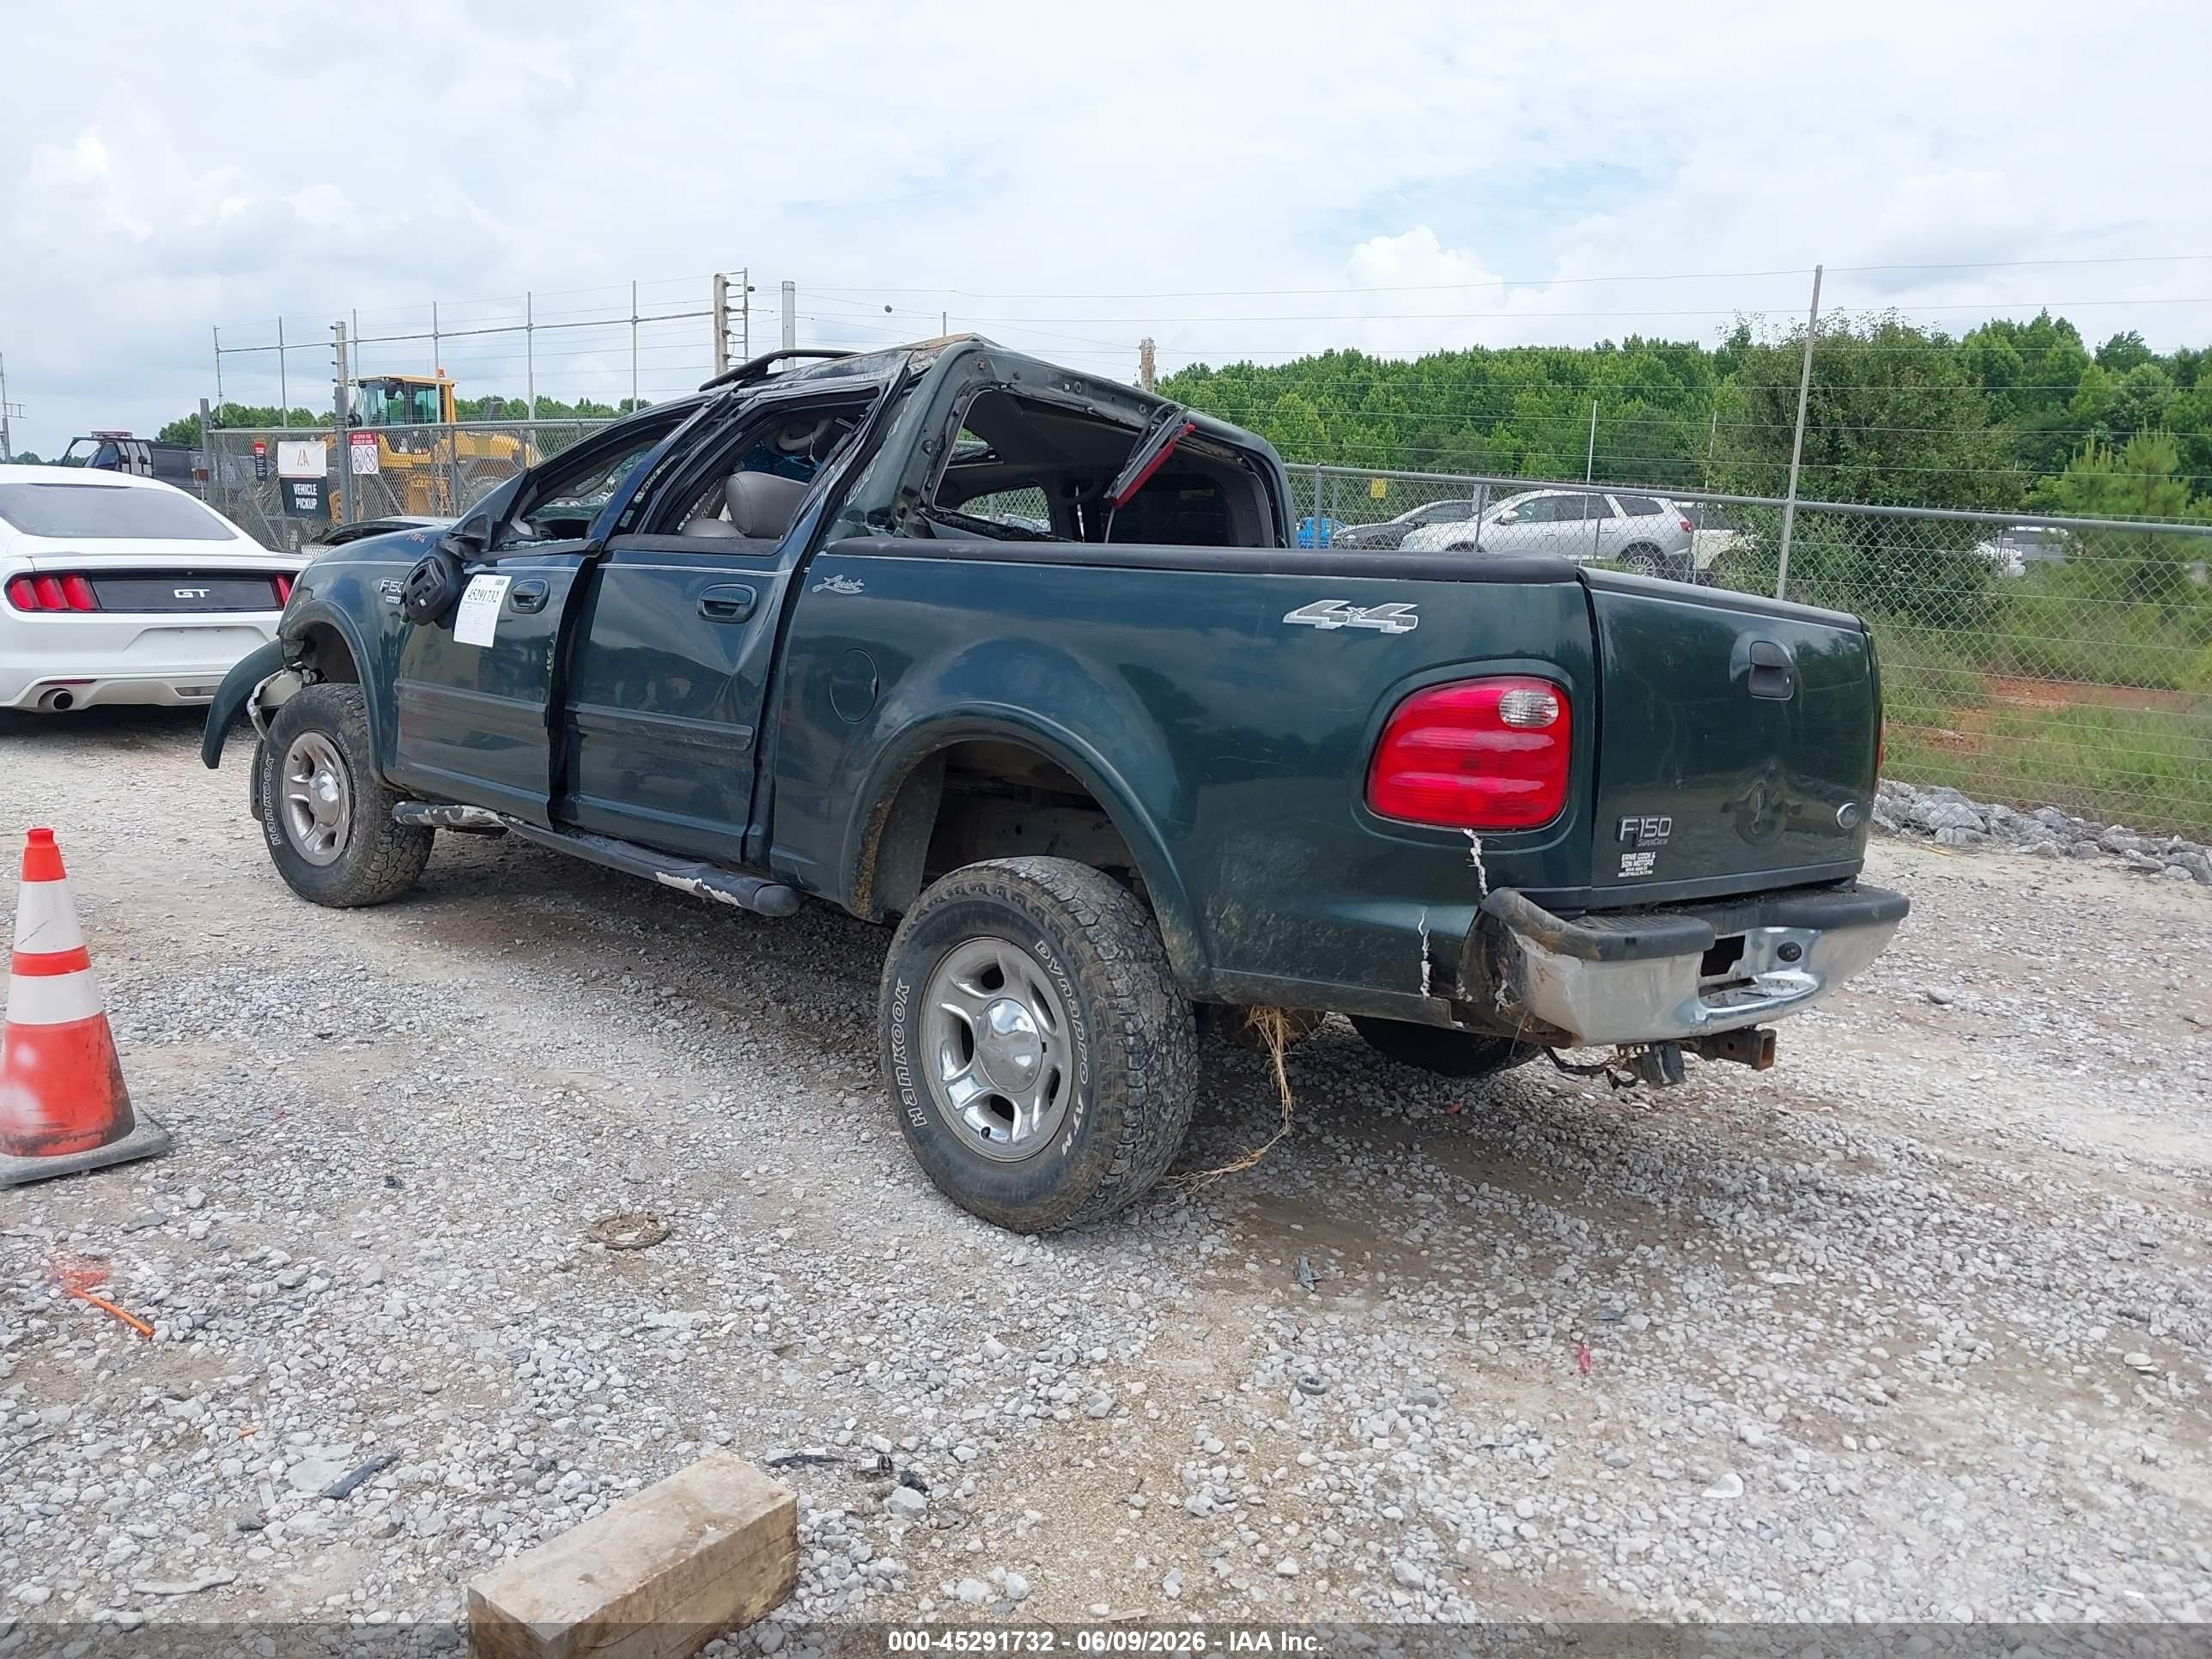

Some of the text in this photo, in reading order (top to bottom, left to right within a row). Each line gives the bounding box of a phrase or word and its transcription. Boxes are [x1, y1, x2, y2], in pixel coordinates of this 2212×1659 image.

[293, 483, 318, 495] VEHICLE
[295, 497, 318, 510] PICKUP
[173, 589, 210, 599] GT
